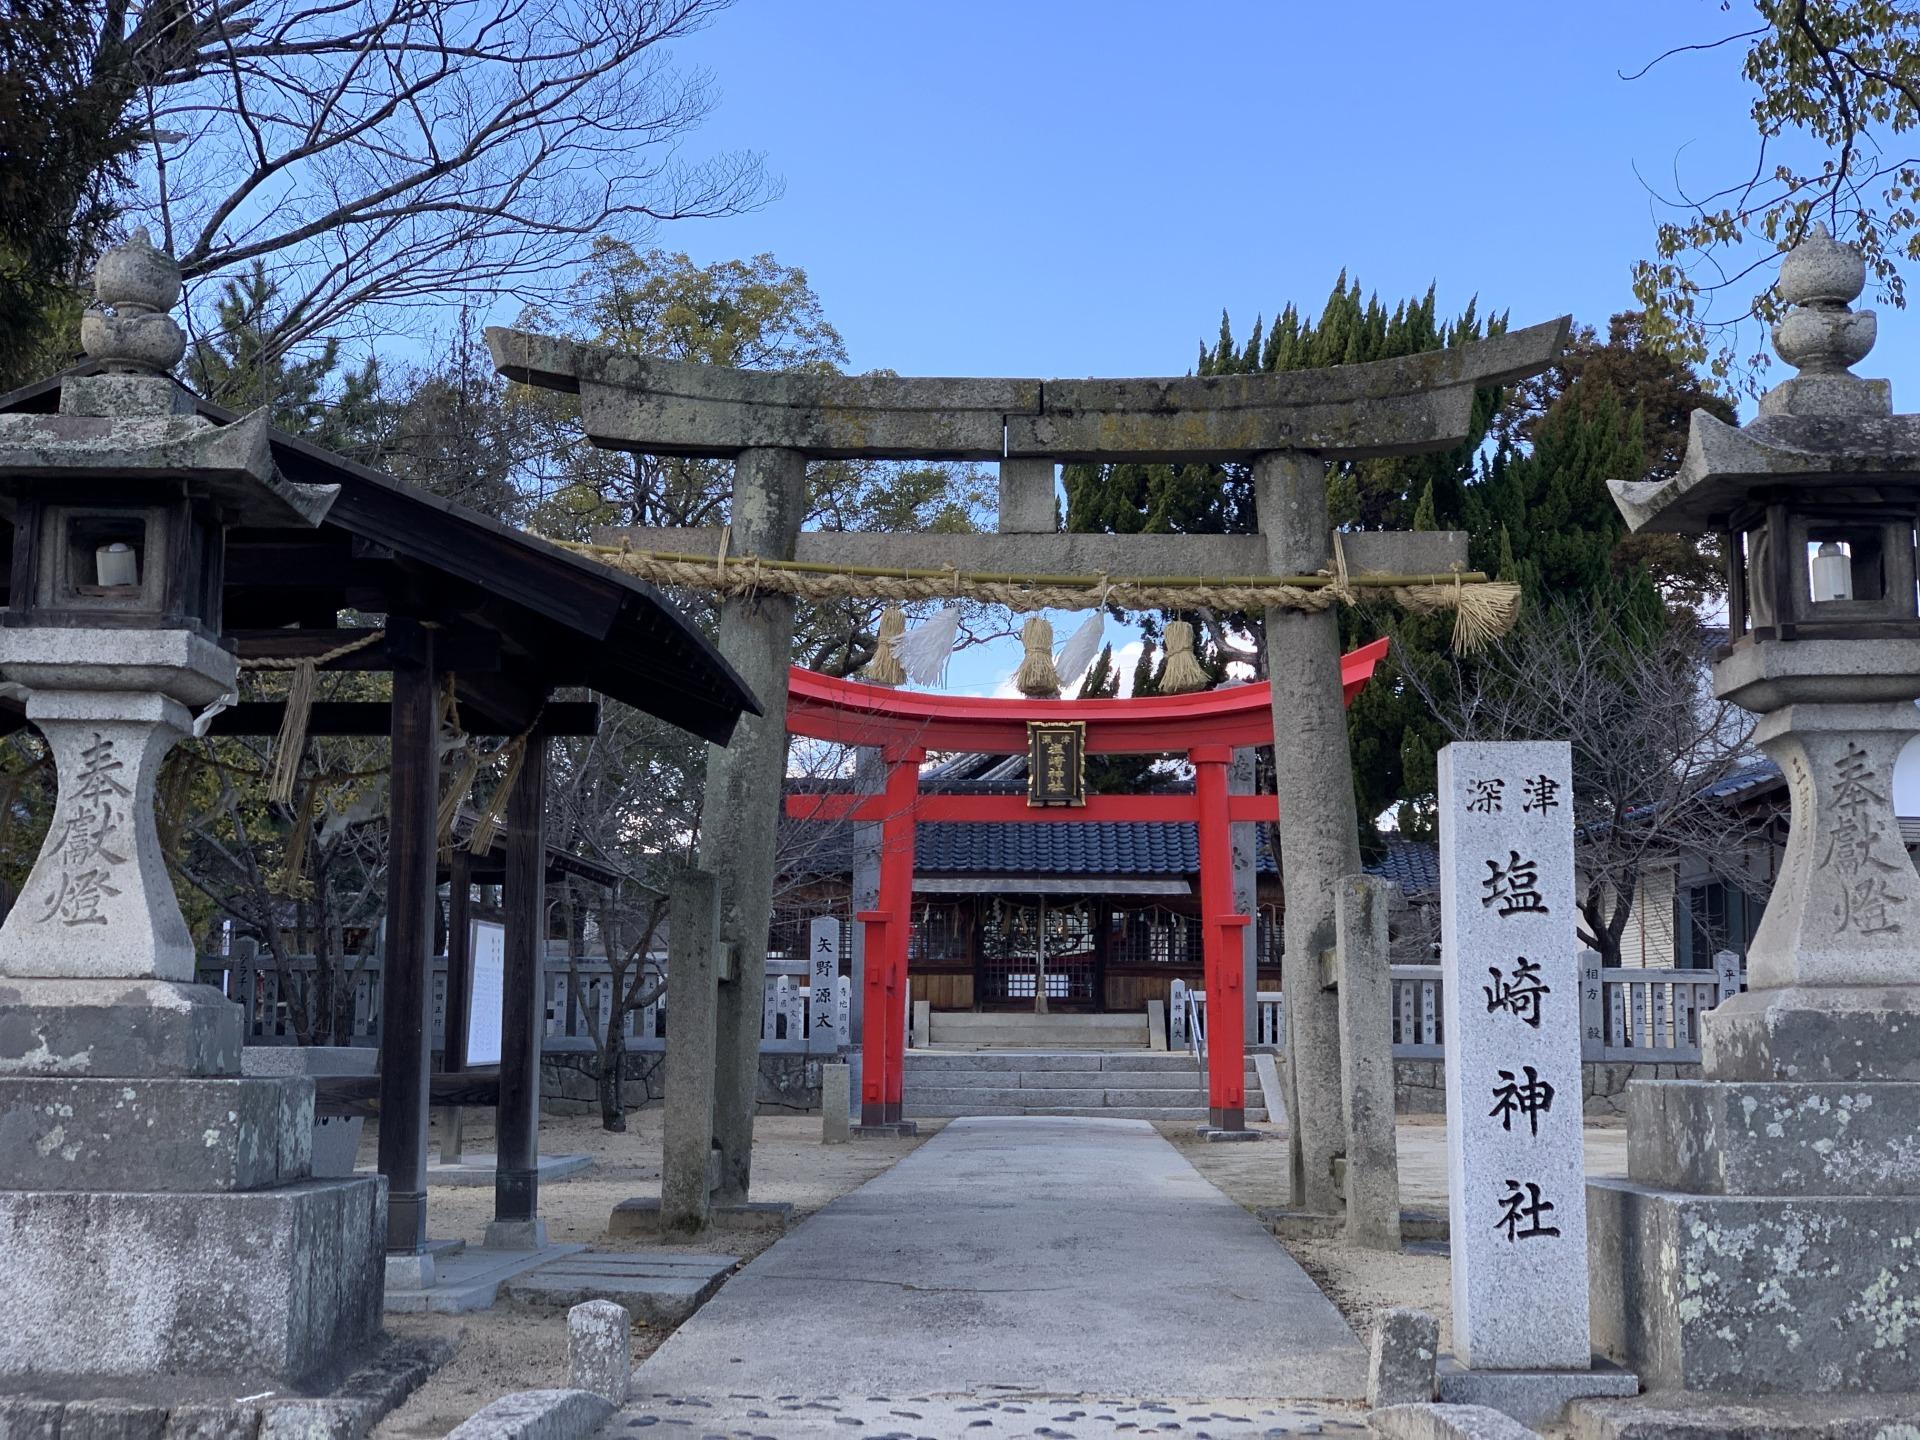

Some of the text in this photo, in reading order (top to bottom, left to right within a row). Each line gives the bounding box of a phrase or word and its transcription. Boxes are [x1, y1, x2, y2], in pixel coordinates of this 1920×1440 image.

[1466, 774, 1560, 817] 深津
[815, 936, 834, 1028] 矢野源太
[1482, 850, 1561, 1243] 塩崎神社
